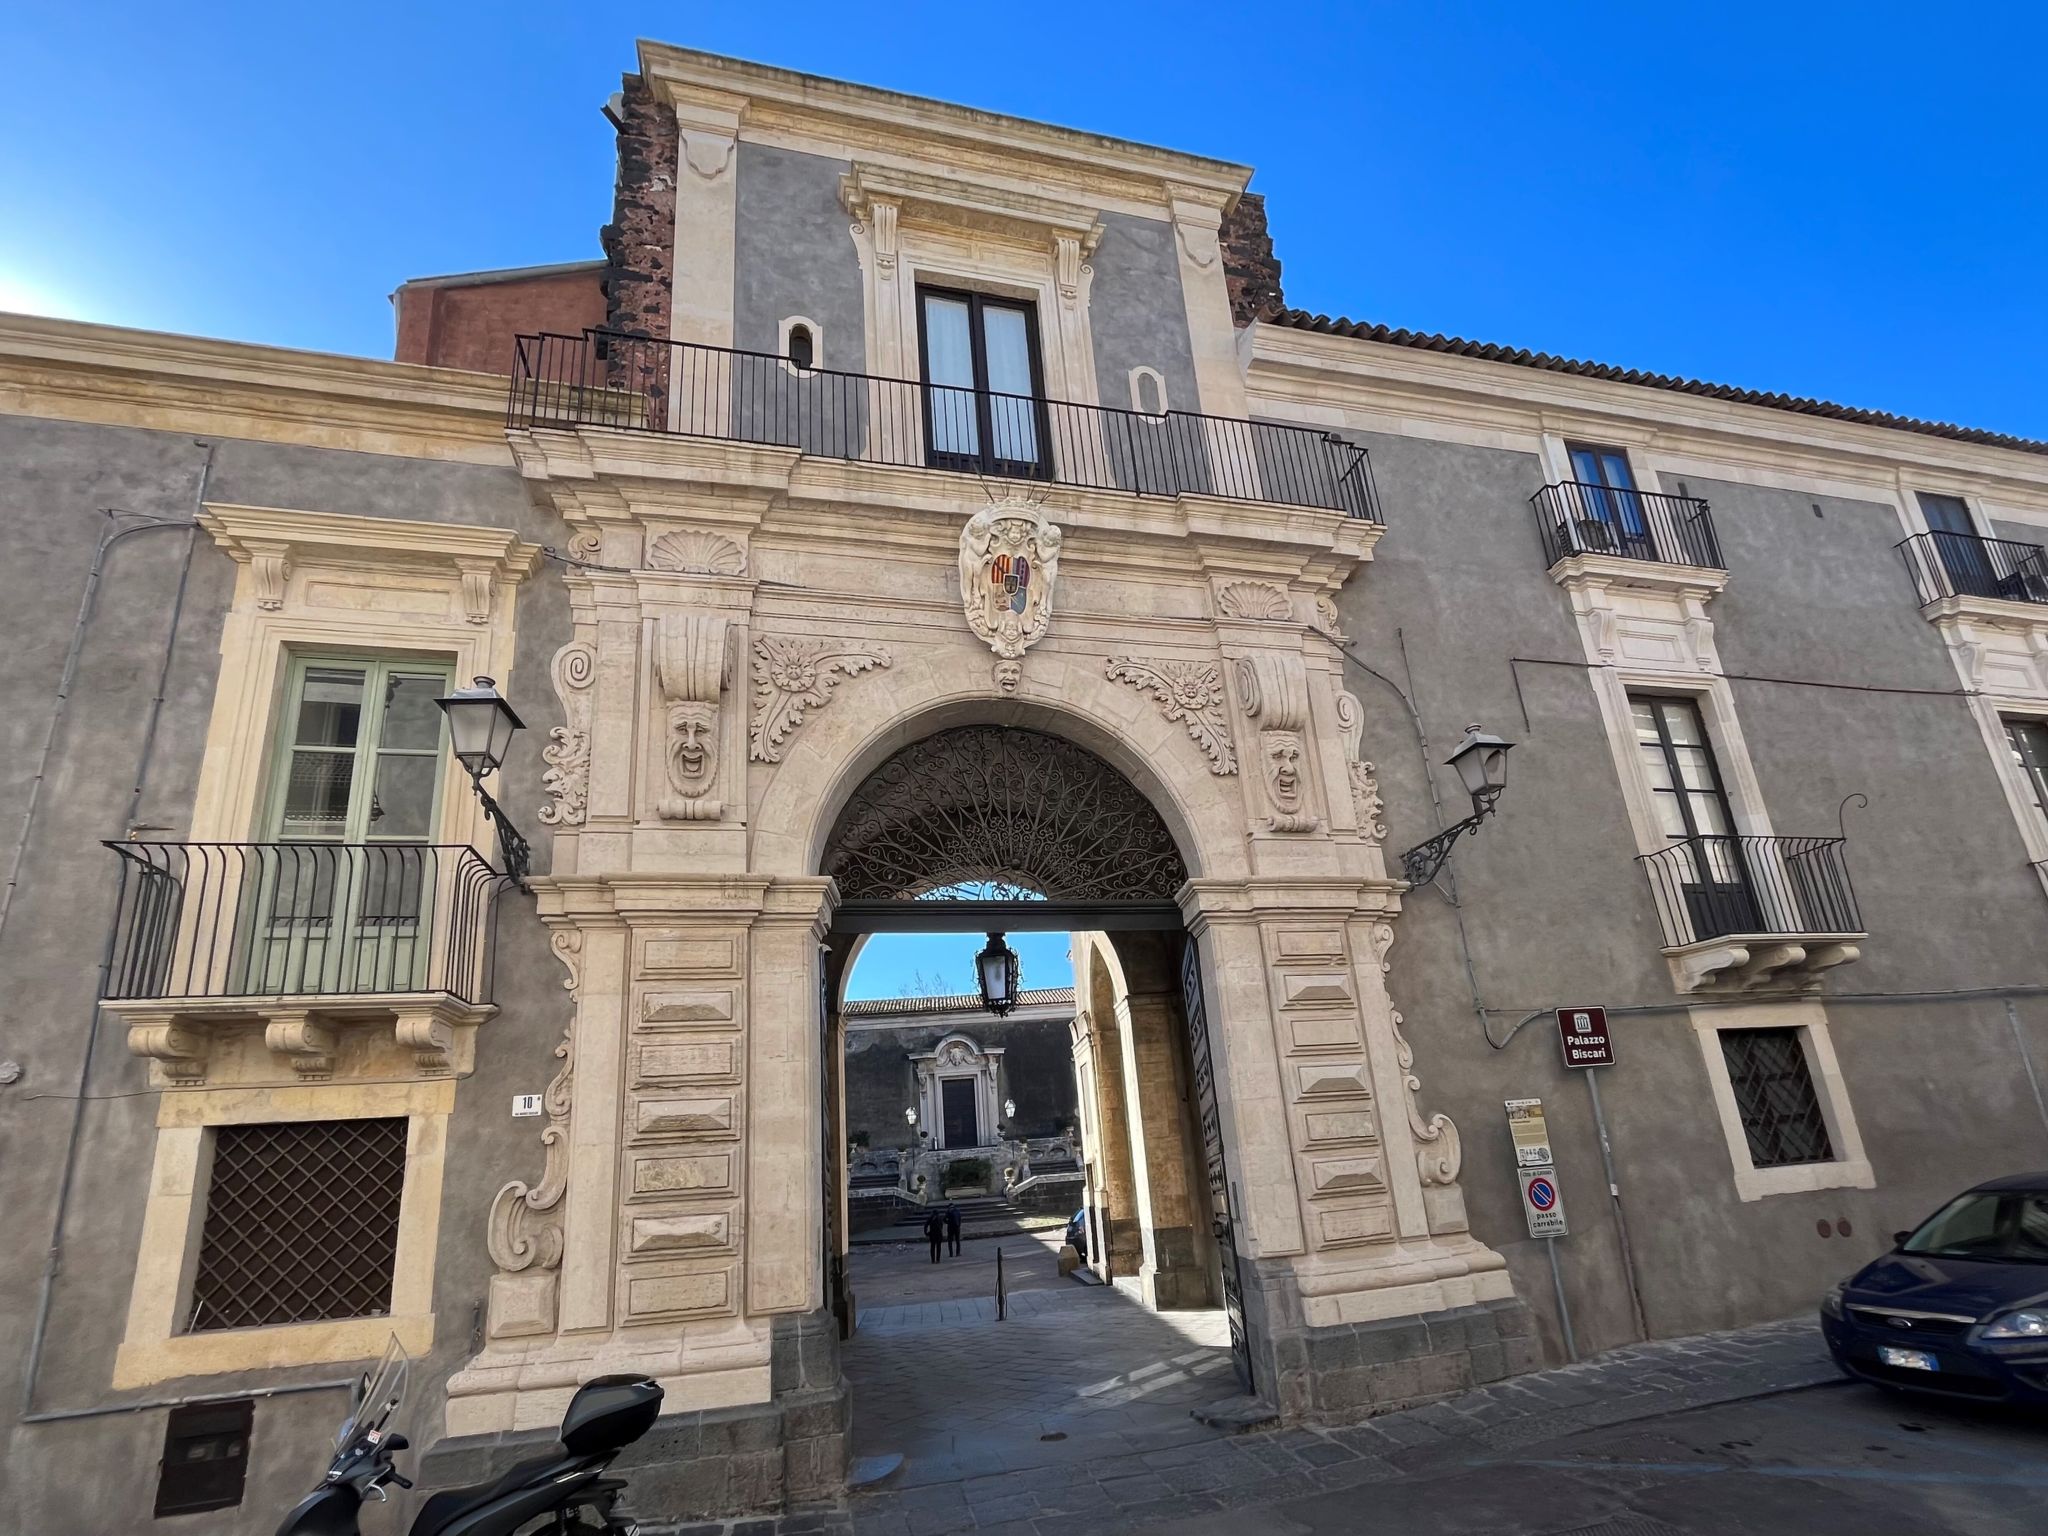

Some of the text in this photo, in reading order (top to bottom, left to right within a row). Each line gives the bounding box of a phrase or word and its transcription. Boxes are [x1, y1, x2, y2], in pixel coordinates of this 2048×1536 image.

[1567, 1035, 1605, 1046] Palazzo
[1571, 1047, 1606, 1059] Biscari
[523, 1096, 533, 1109] 10
[1536, 1212, 1557, 1220] passo
[1532, 1218, 1564, 1228] carrabile
